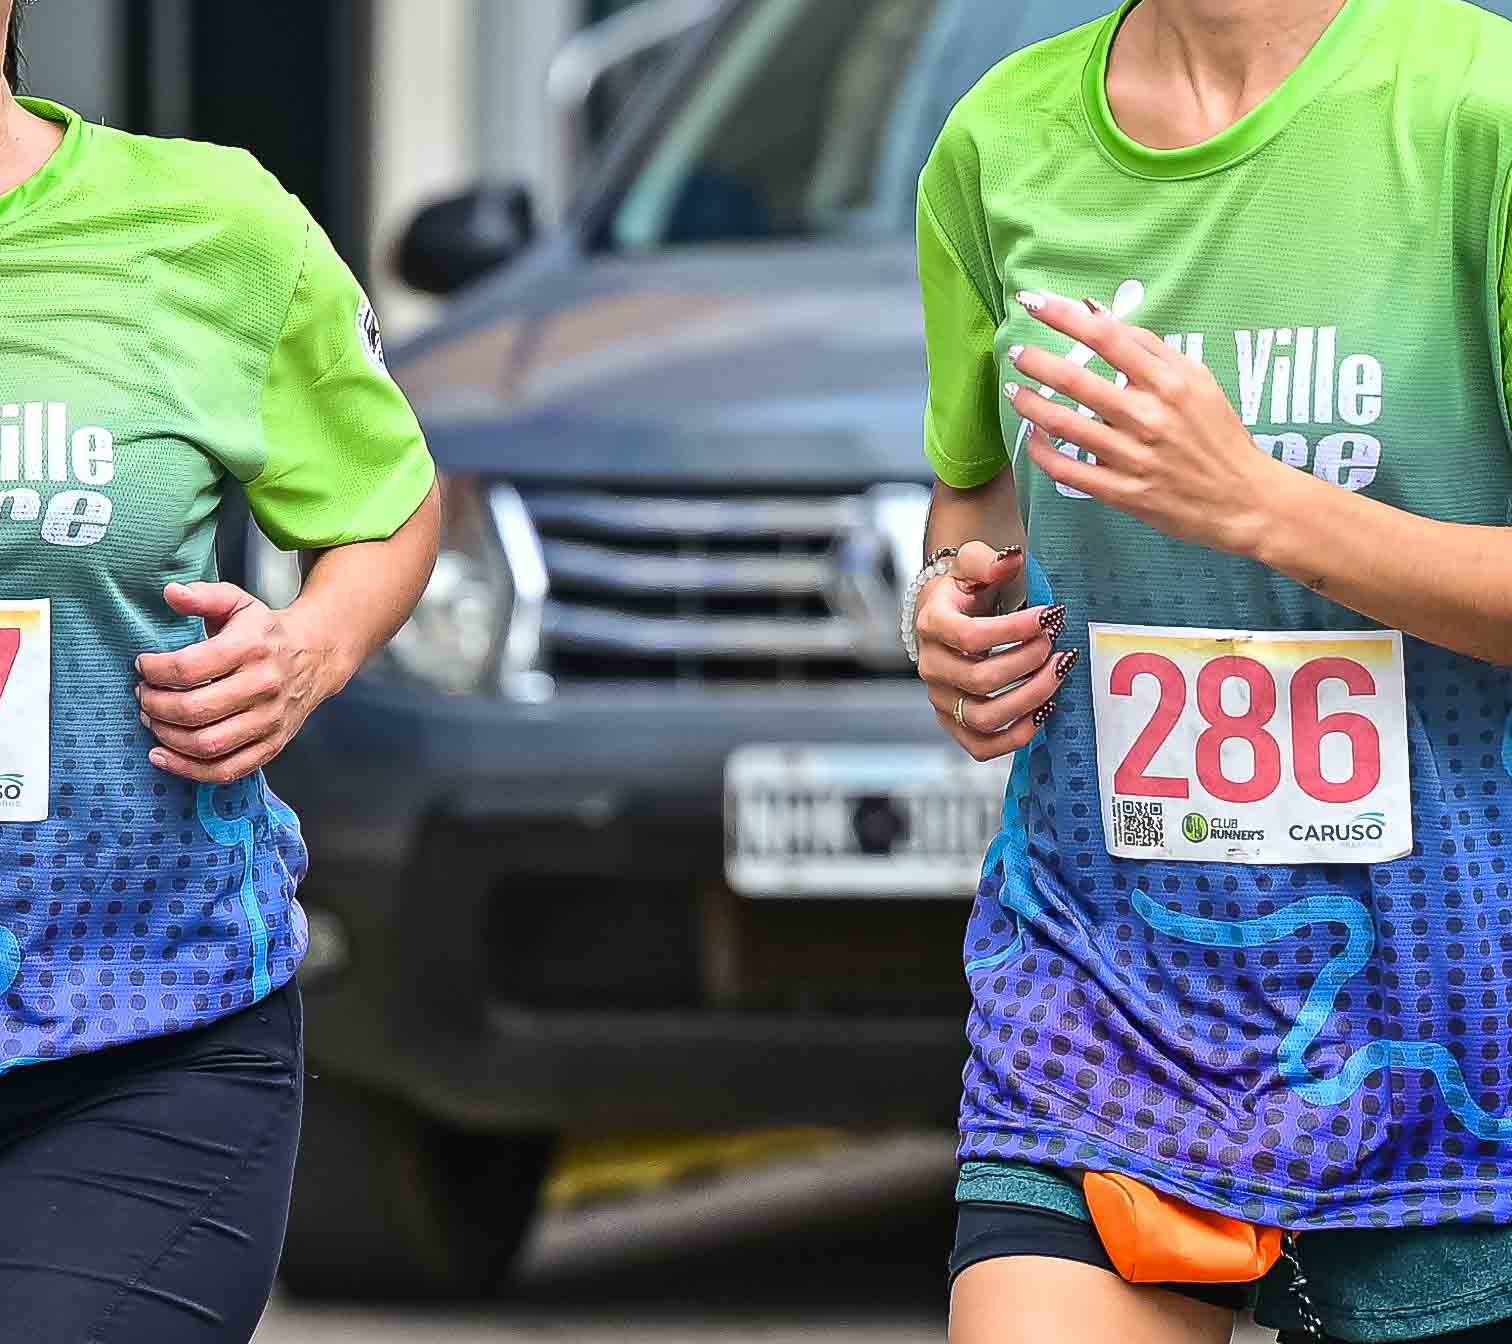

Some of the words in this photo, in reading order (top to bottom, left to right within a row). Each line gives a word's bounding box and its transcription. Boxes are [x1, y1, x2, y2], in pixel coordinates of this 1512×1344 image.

[1233, 326, 1383, 427] Ville
[1110, 652, 1381, 803] 286
[1210, 817, 1238, 829] CLUB
[1209, 829, 1265, 841] RUNNER'S
[1289, 824, 1383, 841] CARUSO
